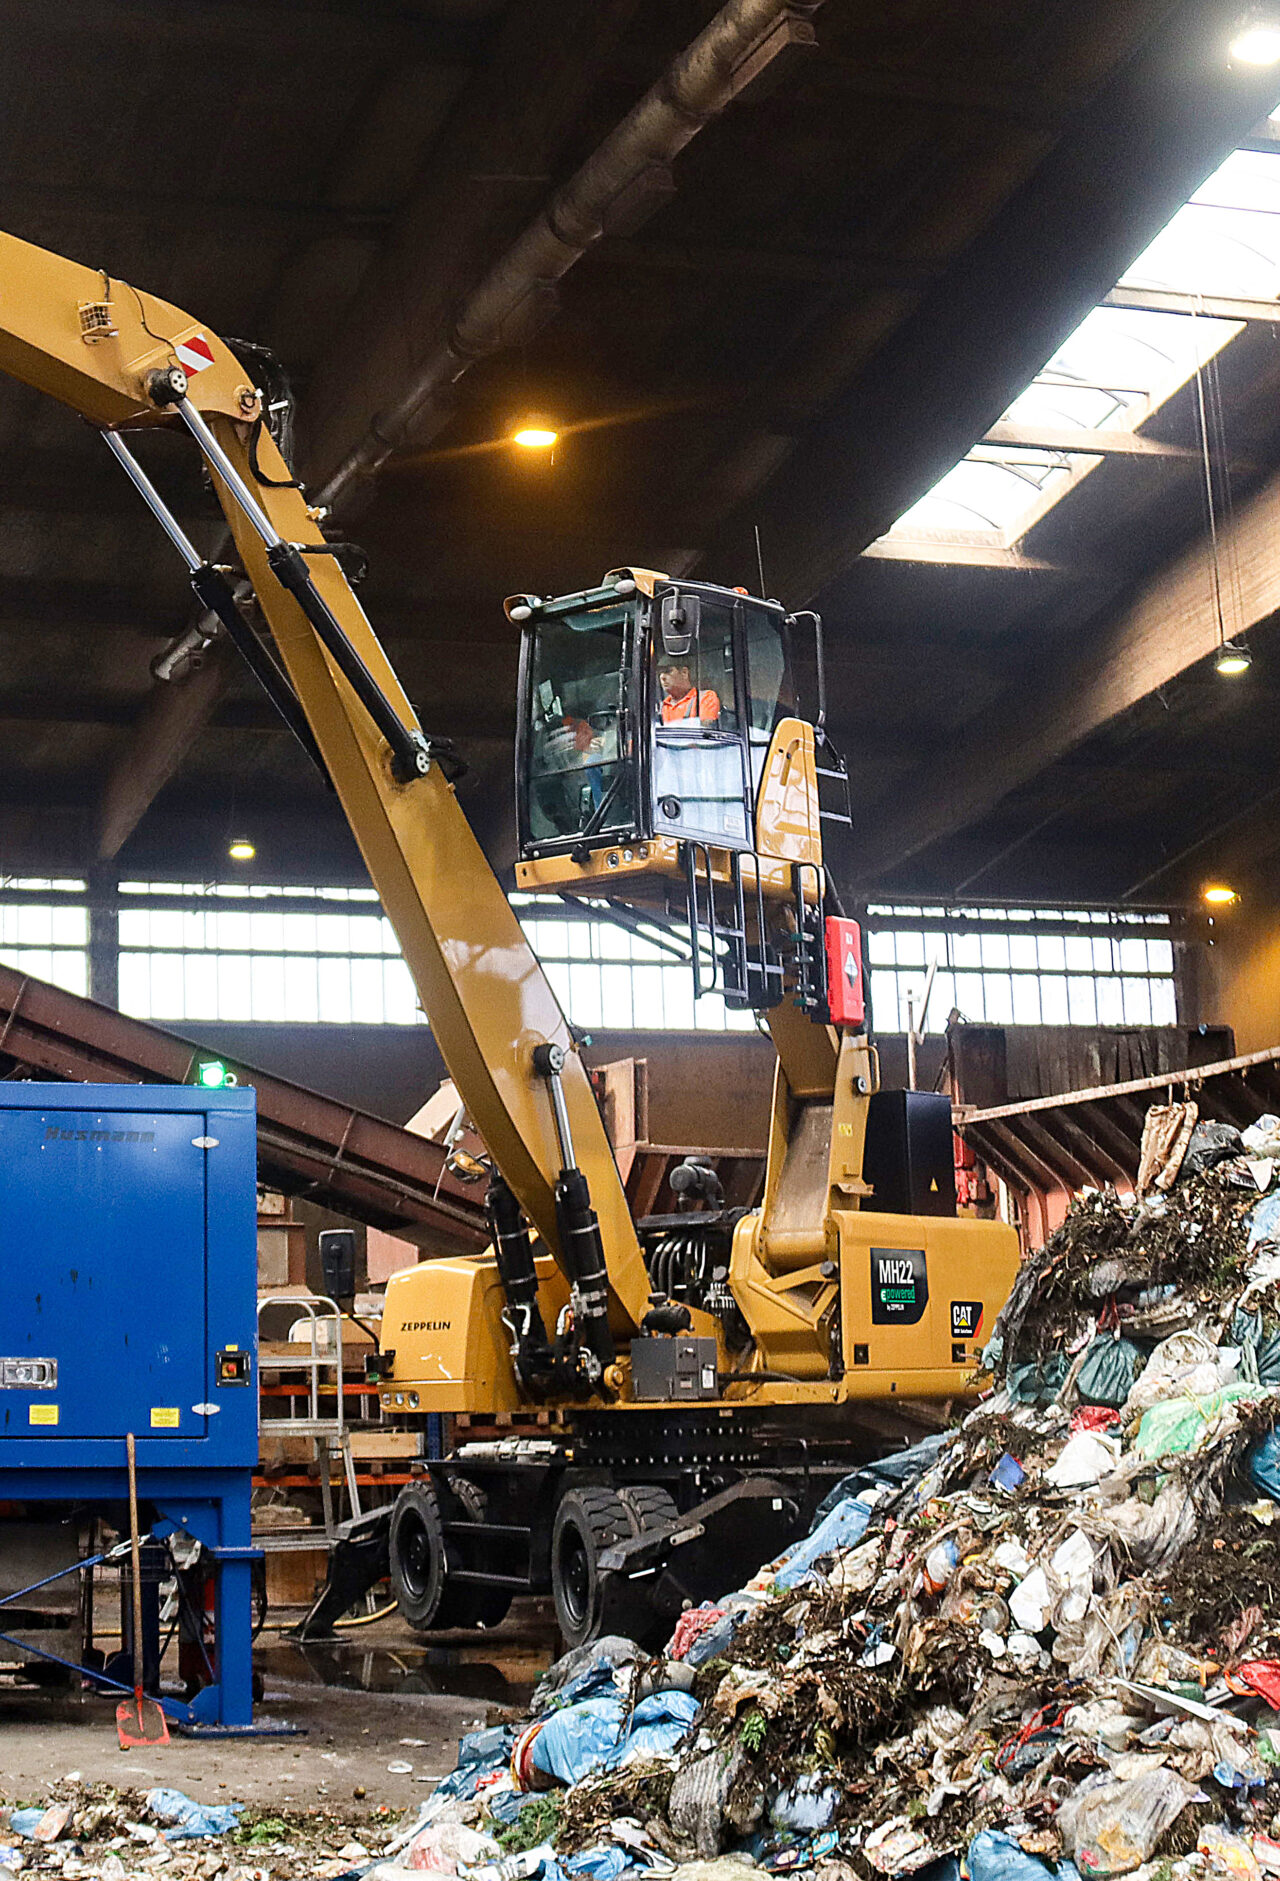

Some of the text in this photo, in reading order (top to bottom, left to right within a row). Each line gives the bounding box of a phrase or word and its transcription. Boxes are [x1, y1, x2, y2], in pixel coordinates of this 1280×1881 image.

[44, 1126, 155, 1142] Husmann
[879, 1260, 914, 1284] MH22
[953, 1305, 972, 1326] CAT
[401, 1321, 451, 1331] ZEPPELIN
